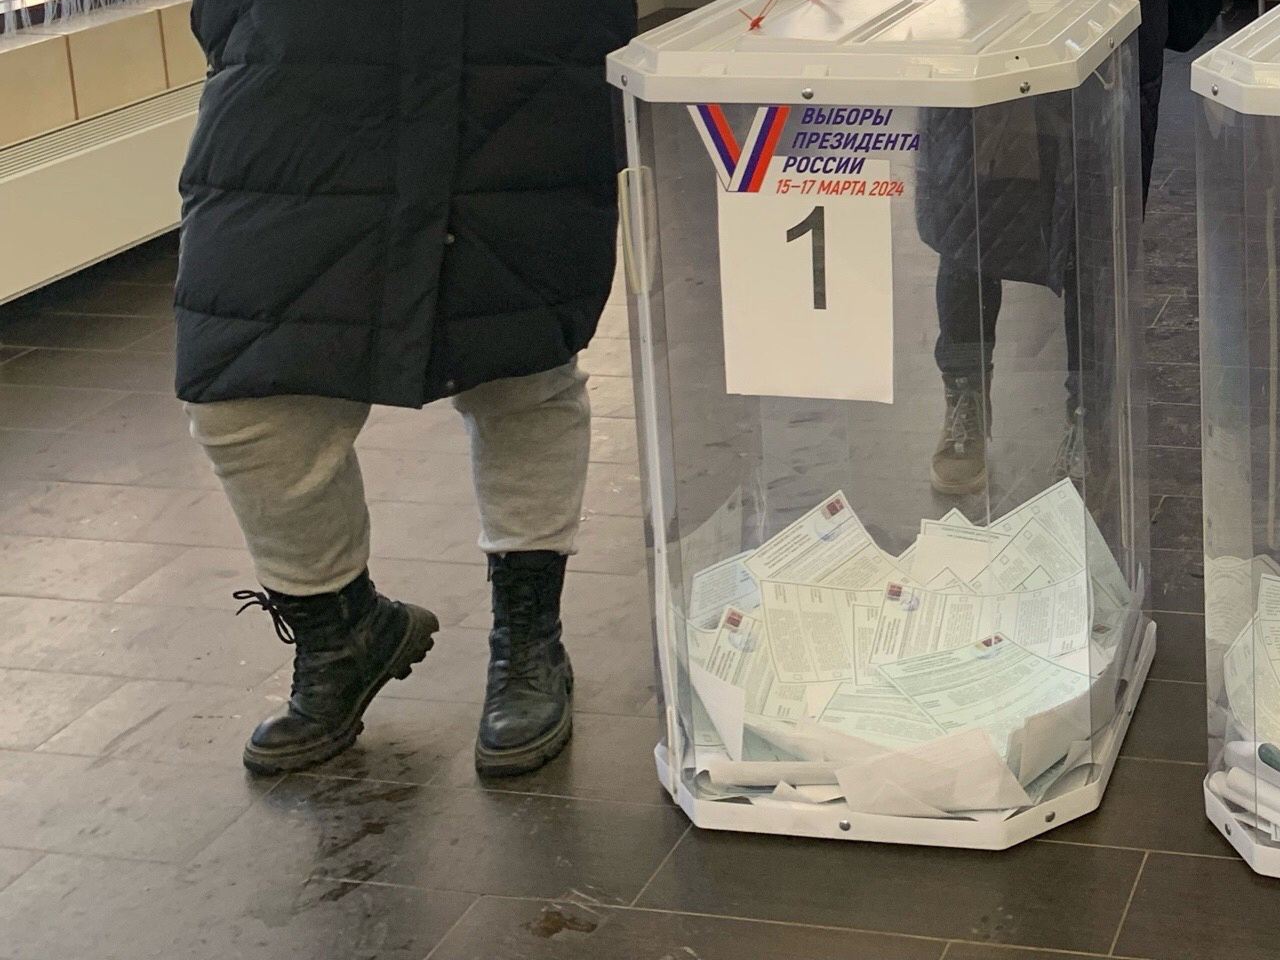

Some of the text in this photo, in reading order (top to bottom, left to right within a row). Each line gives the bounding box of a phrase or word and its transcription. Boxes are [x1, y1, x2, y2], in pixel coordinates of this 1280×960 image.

[801, 107, 893, 126] ВЫБОРЫ
[792, 131, 921, 153] ПРЕЗИДЕНТА
[782, 156, 866, 175] РОССИИ
[817, 180, 866, 196] МАРТА
[869, 181, 904, 197] 2024
[786, 205, 827, 310] 1
